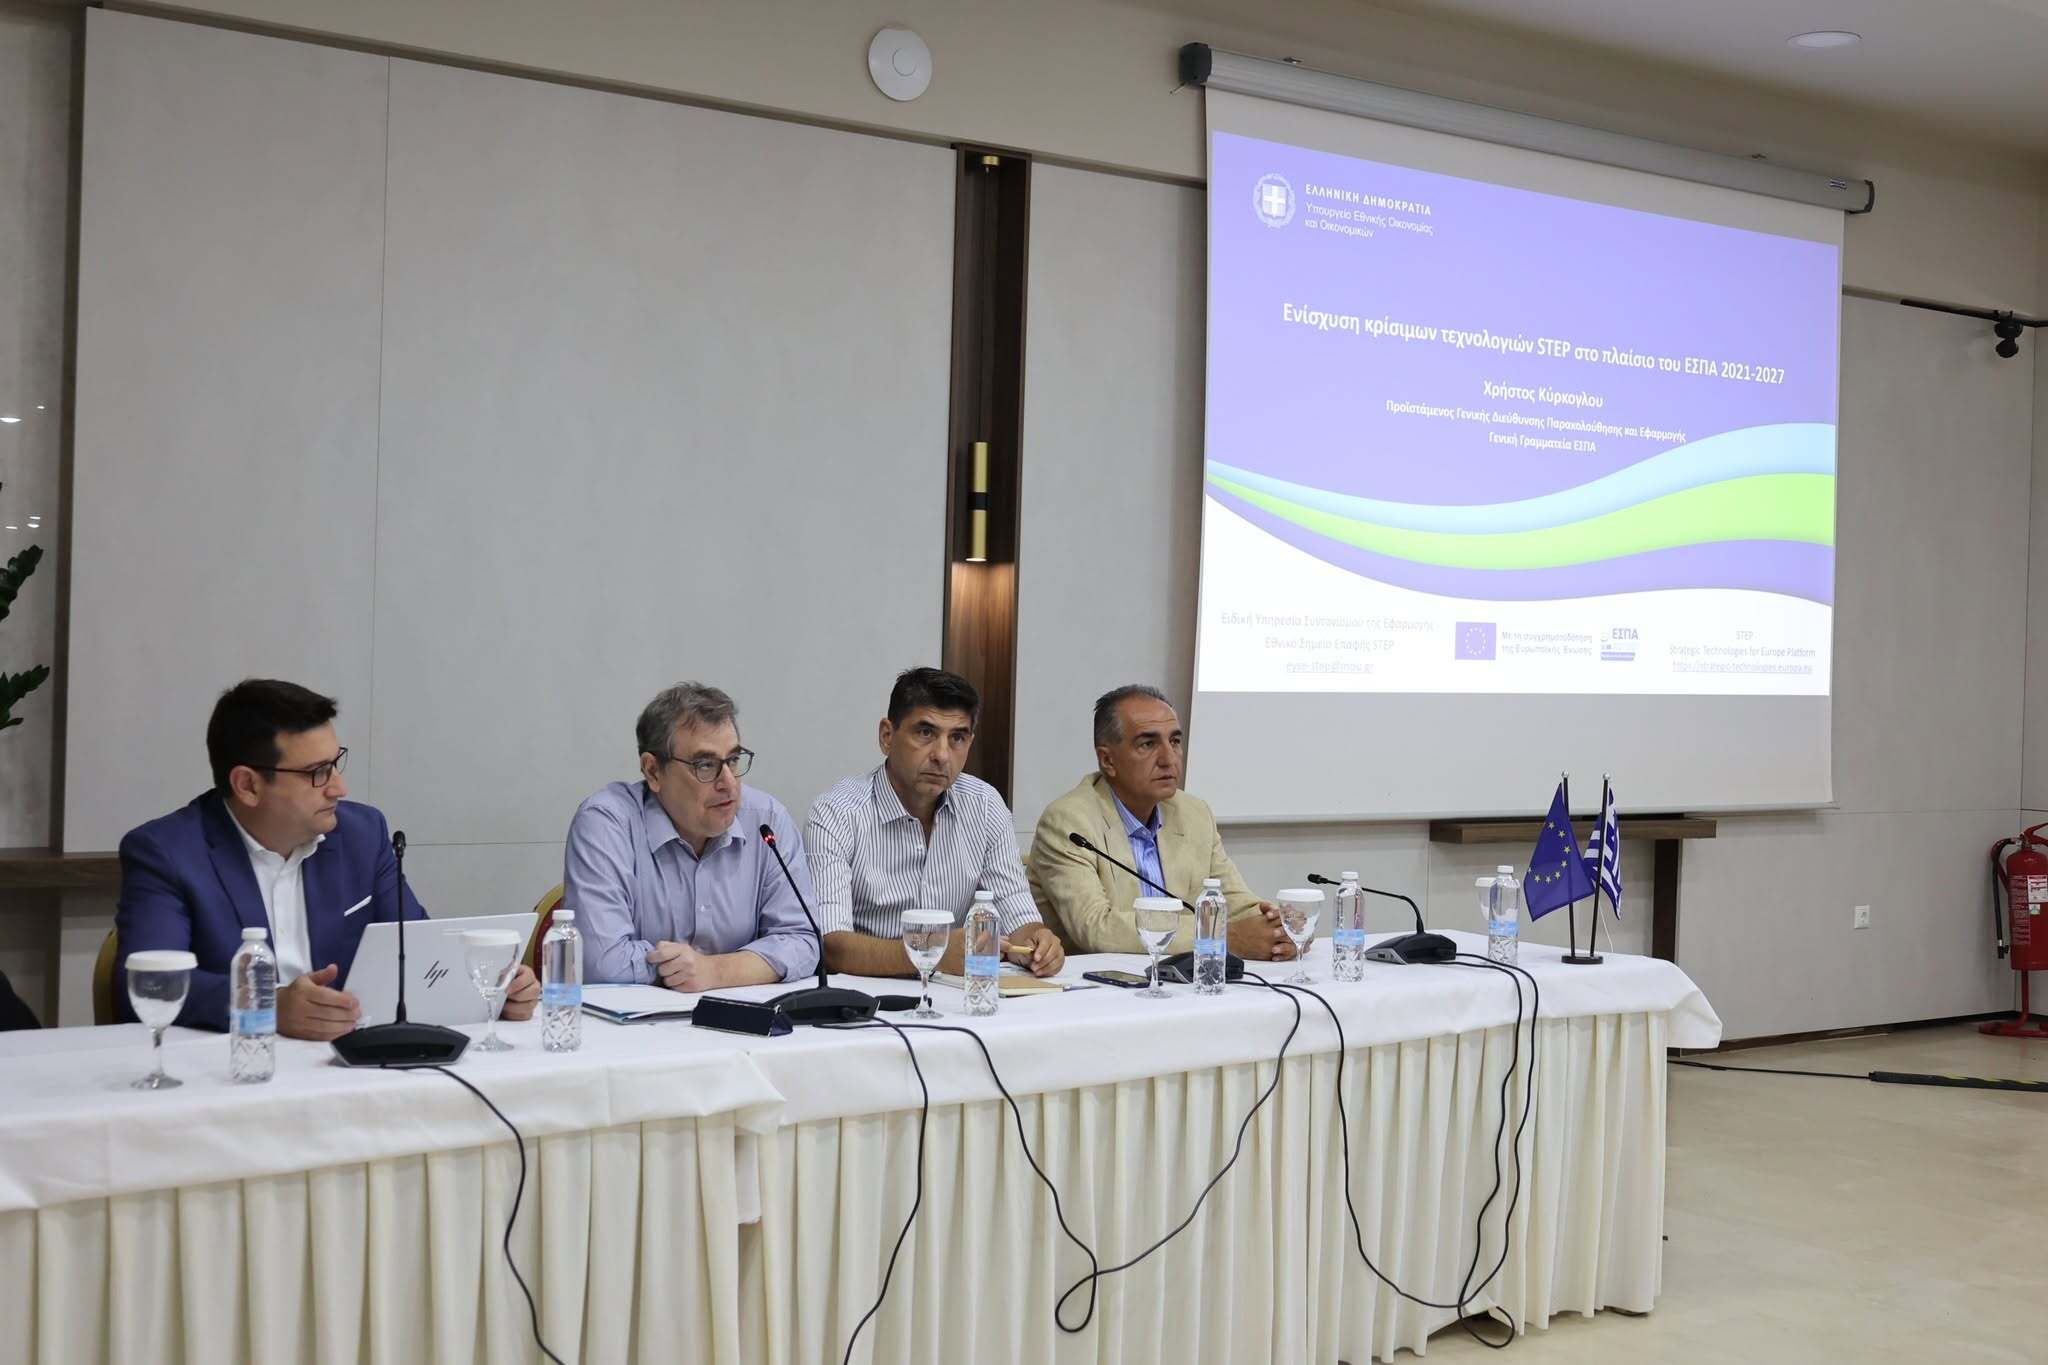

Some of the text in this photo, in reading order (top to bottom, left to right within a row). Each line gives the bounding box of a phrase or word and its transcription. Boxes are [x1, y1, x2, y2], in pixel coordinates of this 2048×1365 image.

[1305, 184, 1432, 216] ΕΛΛΗΝΙΚΗ ΔΗΜΟΚΡΑΤΙΑ
[1304, 219, 1375, 238] και Οικονομικών
[1305, 202, 1434, 237] Υπουργείο Εθνικής Οικονομίας
[1283, 303, 1786, 385] Ενίσχυση κρίσιμων τεχνολογιών STEP στο πλαίσιο του ΕΣΠΑ 2021-2027
[1483, 380, 1604, 408] Χρήστος Κύρκογλου
[1385, 399, 1687, 444] Προϊστάμενος Γενικής Διεύθυνσης Παρακολούθησης και Εφαρμογής
[1488, 431, 1597, 452] Γενική Γραμματεία ΕΣΠΑ
[1372, 639, 1395, 651] STEP
[1612, 628, 1639, 640] ΕΣΠΑ
[1761, 646, 1786, 659] Europe
[1786, 647, 1817, 658] Platform
[424, 960, 449, 989] hp
